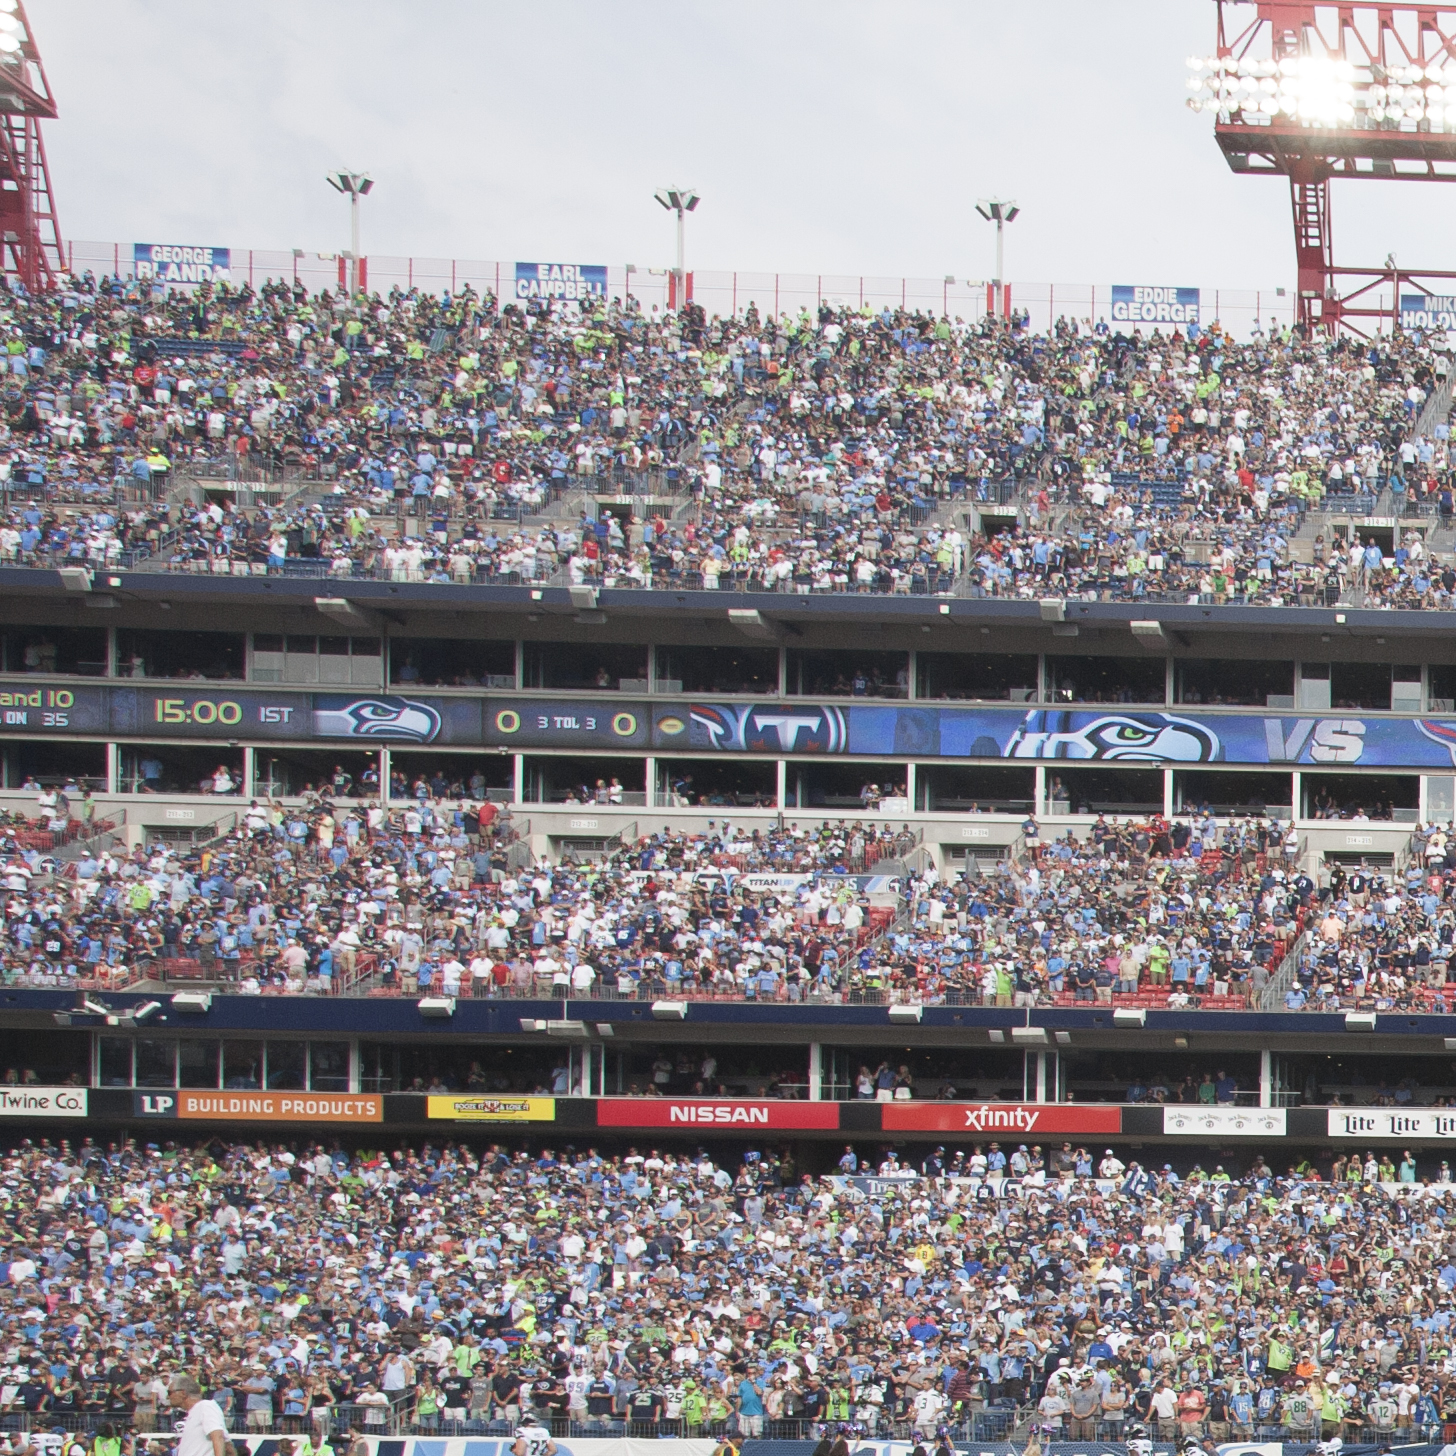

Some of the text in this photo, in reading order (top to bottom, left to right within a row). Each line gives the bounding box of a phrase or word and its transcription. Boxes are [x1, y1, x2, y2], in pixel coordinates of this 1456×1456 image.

[151, 246, 213, 264] GEORGE
[538, 264, 585, 281] EARL
[1134, 287, 1178, 304] EDDIE
[1113, 304, 1198, 323] GEORGE
[48, 690, 75, 708] 10
[6, 711, 69, 726] ON 35
[155, 699, 243, 725] 15:00
[496, 710, 520, 733] 0
[538, 716, 549, 729] 3
[586, 717, 597, 730] 3
[612, 713, 637, 736] 0
[1264, 719, 1366, 763] VS
[0, 1092, 83, 1110] Twine Co.
[142, 1096, 174, 1113] LP
[187, 1098, 376, 1116] BUILDING PRODUCTS
[671, 1106, 768, 1123] NISSAN
[965, 1105, 1039, 1131] xfinity
[1345, 1116, 1375, 1134] Lite
[1390, 1116, 1420, 1135] Lite
[635, 1392, 651, 1406] 25
[667, 1391, 682, 1404] 25
[1294, 1402, 1306, 1413] 88
[1378, 1406, 1388, 1417] 12
